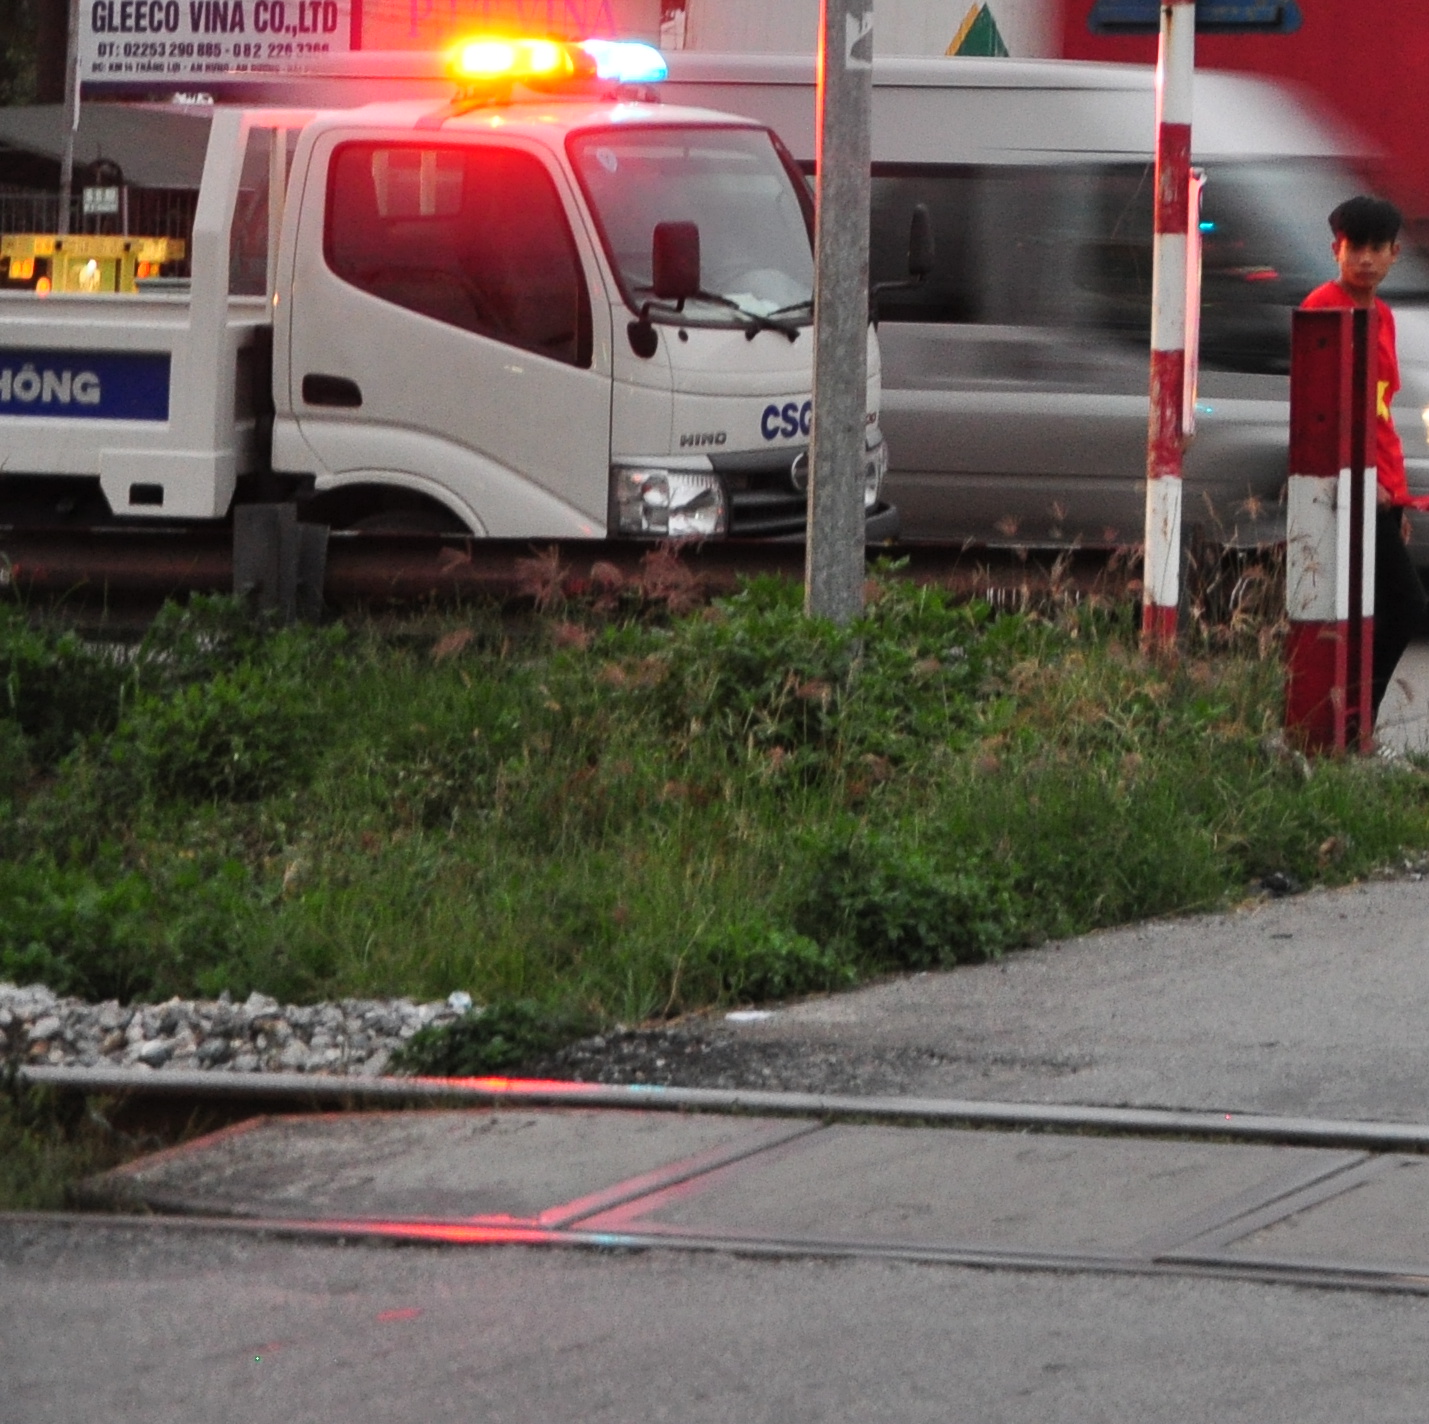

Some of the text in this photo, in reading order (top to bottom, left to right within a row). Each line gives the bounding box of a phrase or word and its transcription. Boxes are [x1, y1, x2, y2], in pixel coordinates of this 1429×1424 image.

[91, 0, 338, 38] GLEECO VINA CO.,LTD
[168, 41, 194, 58] 290
[680, 432, 728, 448] HINO
